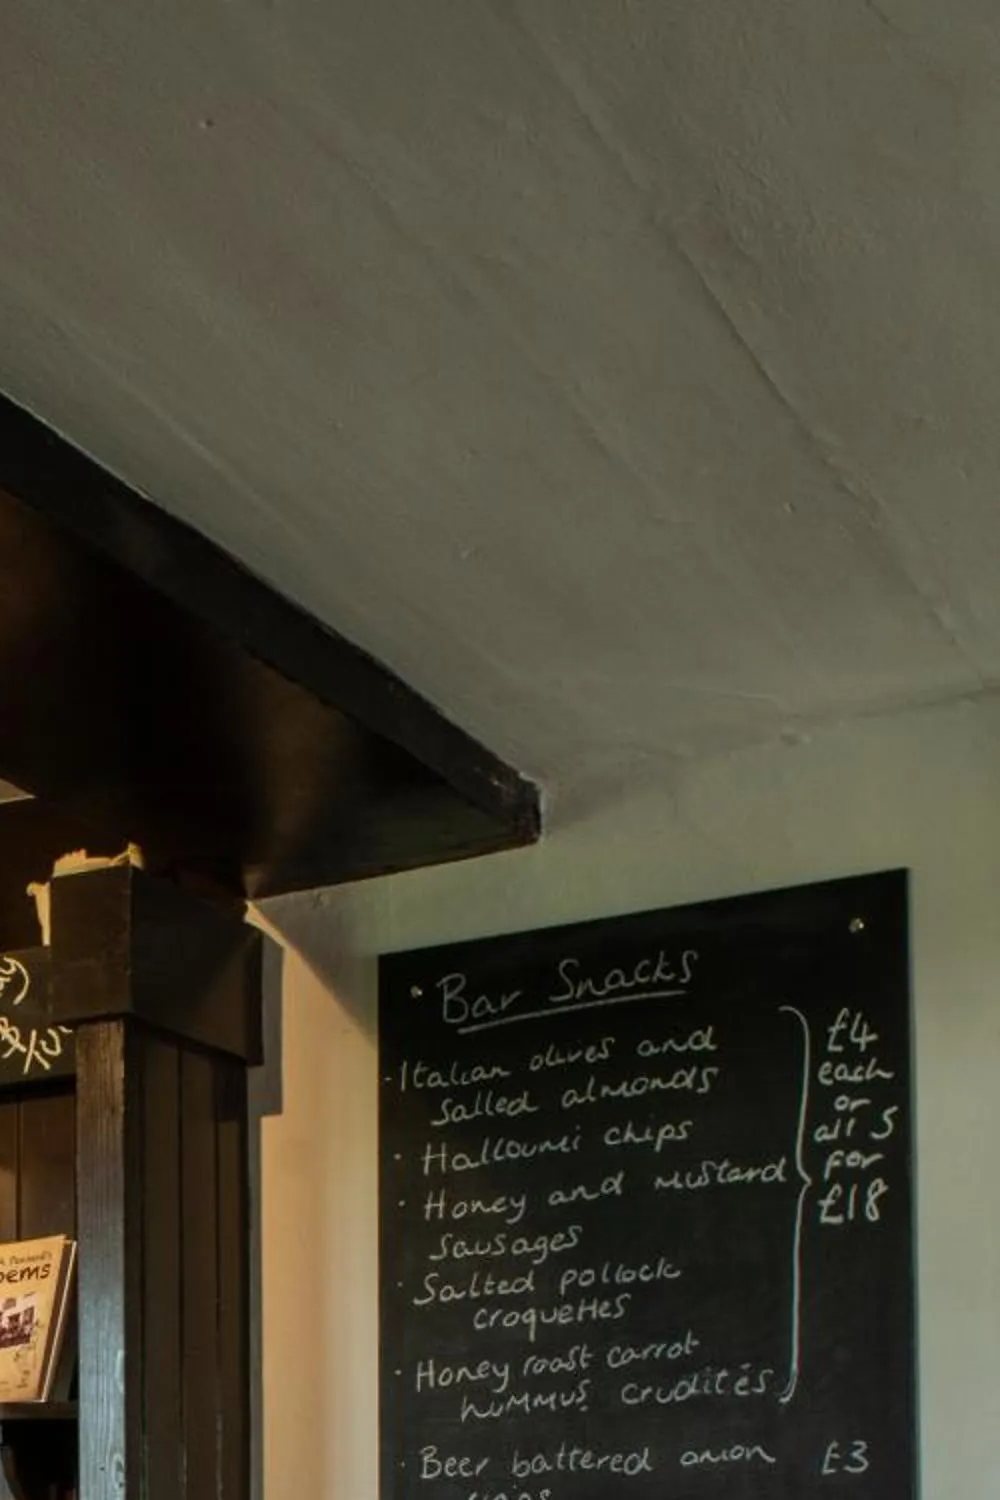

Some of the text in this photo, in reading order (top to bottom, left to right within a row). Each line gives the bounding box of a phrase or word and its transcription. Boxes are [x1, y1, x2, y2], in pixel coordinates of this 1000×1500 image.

[435, 949, 699, 1024] Bar Snacks
[825, 1006, 880, 1054] £4
[400, 1025, 719, 1093] Italian olives and
[817, 1057, 895, 1086] each
[561, 1066, 719, 1110] almonds
[833, 1095, 872, 1113] or
[420, 1120, 694, 1176] Halloumi chips
[812, 1117, 857, 1143] all
[822, 1149, 884, 1181] for
[422, 1156, 787, 1225] Honey and mustard
[816, 1177, 890, 1225] £18
[413, 1257, 682, 1306] Salted pollock
[472, 1293, 632, 1344] croquettes
[415, 1328, 700, 1393] Honey roast carrot
[419, 1440, 870, 1480] Beer battered onion £3
